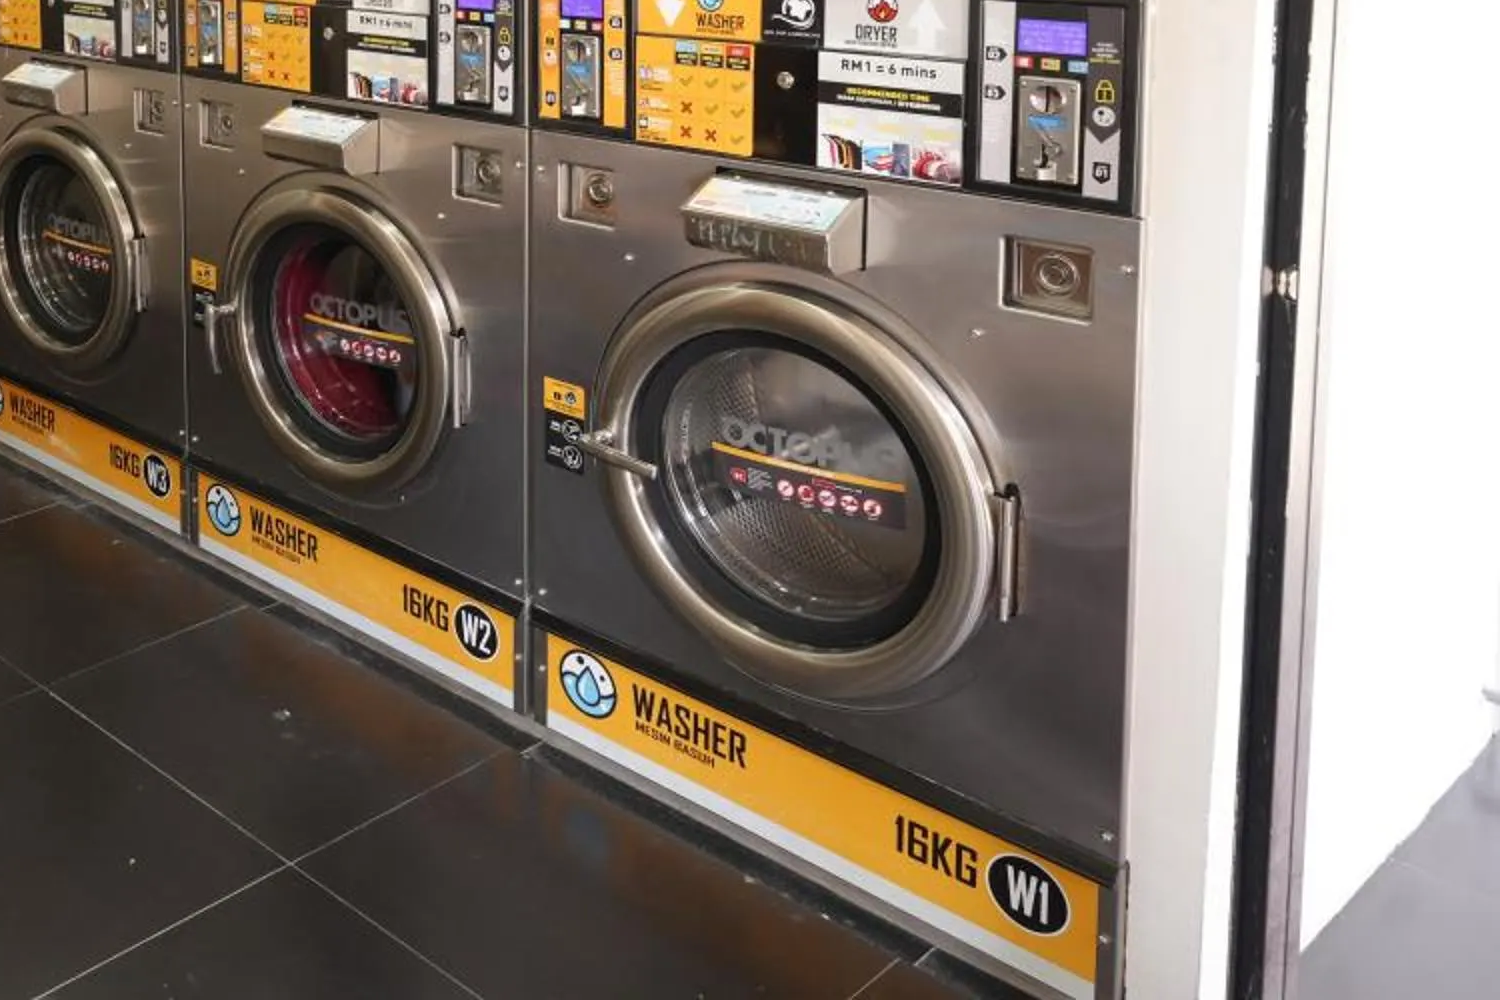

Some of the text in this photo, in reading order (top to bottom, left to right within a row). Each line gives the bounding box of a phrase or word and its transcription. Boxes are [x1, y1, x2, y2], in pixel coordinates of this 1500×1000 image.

[695, 12, 745, 31] WASHER
[855, 23, 898, 43] DRYER
[841, 60, 871, 73] RM1
[888, 64, 897, 75] 6
[901, 65, 937, 79] mins
[310, 293, 412, 330] OCTOPUS
[10, 391, 55, 432] WASHER
[109, 443, 140, 478] 16KG
[145, 458, 169, 493] W3
[249, 506, 318, 562] WASHER
[403, 583, 449, 632] 16KG
[461, 609, 491, 655] W2
[632, 683, 748, 769] WASHER
[635, 720, 716, 769] MESIN BASUH
[895, 814, 979, 889] 16KG
[1006, 863, 1050, 926] W1
